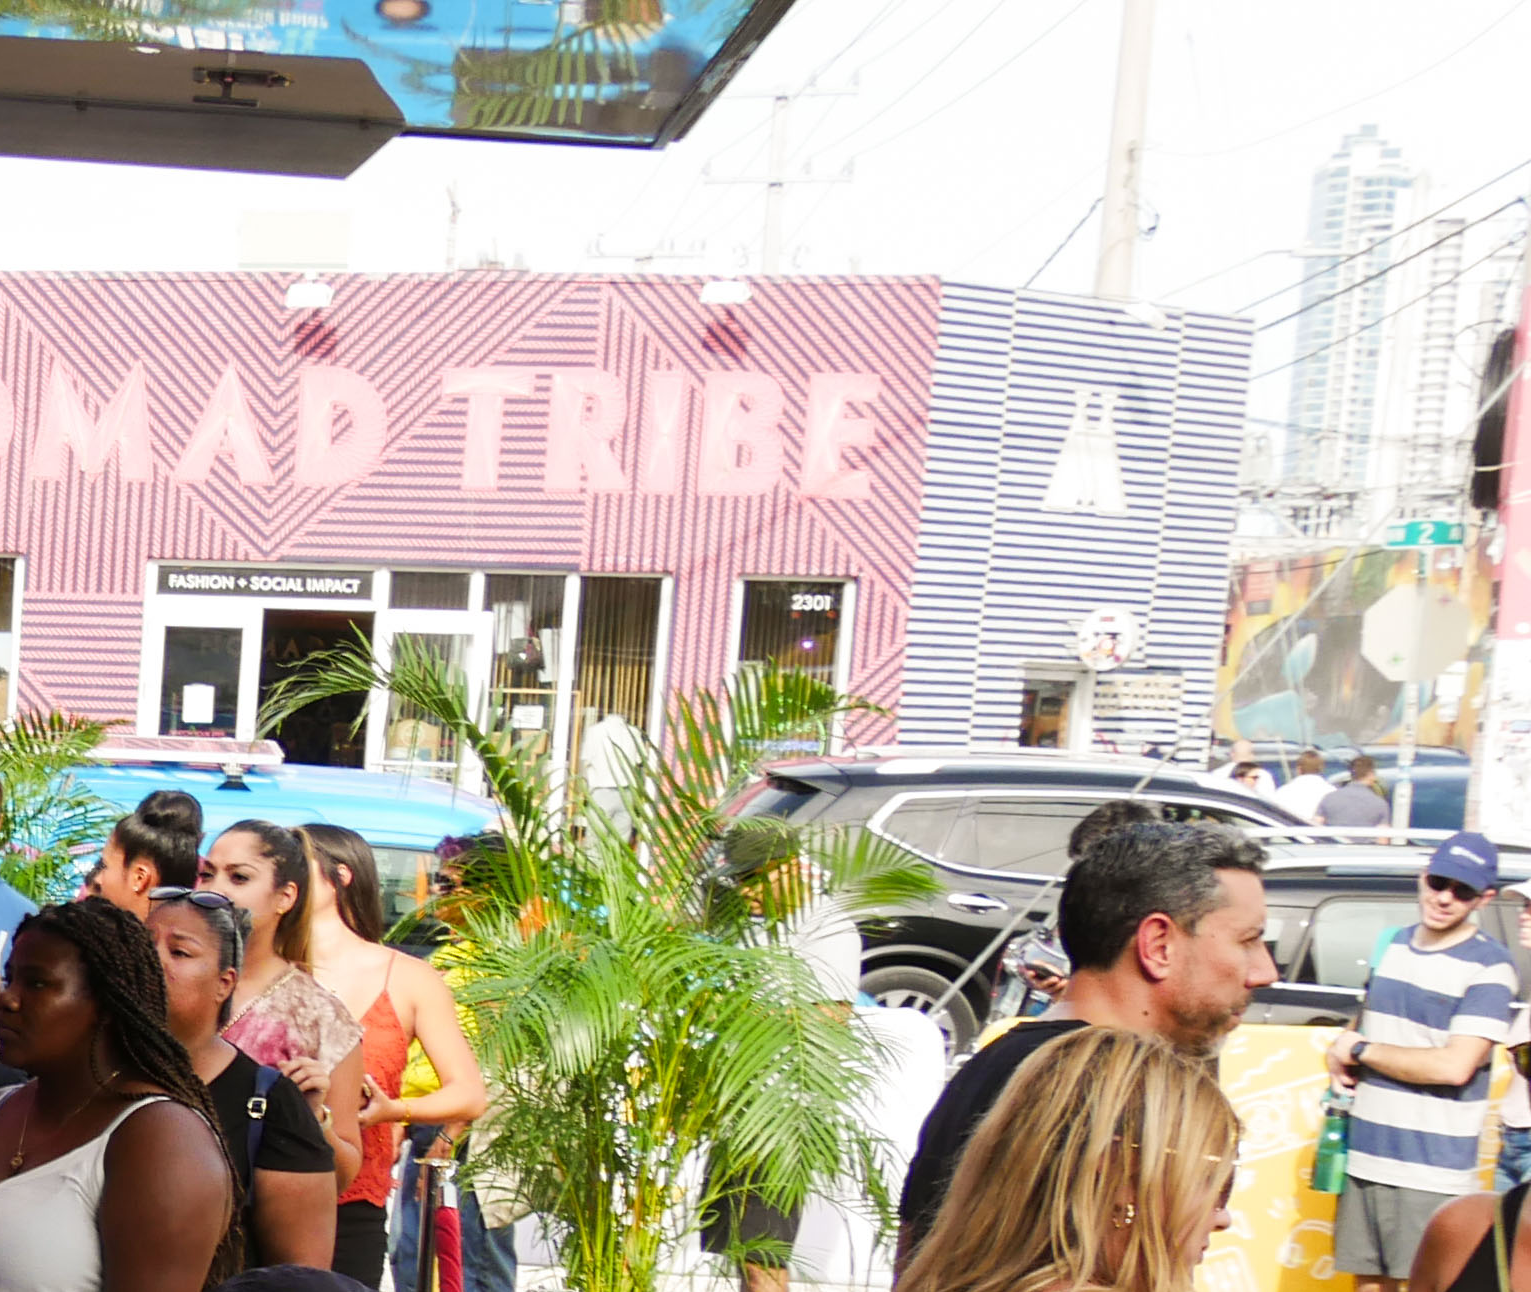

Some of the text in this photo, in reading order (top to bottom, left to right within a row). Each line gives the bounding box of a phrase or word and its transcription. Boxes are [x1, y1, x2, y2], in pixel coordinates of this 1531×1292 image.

[441, 365, 881, 502] TRIBE
[1419, 522, 1435, 545] 2
[168, 574, 234, 590] FASHION
[249, 576, 304, 592] SOCIAL
[306, 578, 361, 594] IMPACT
[791, 594, 832, 611] 2301
